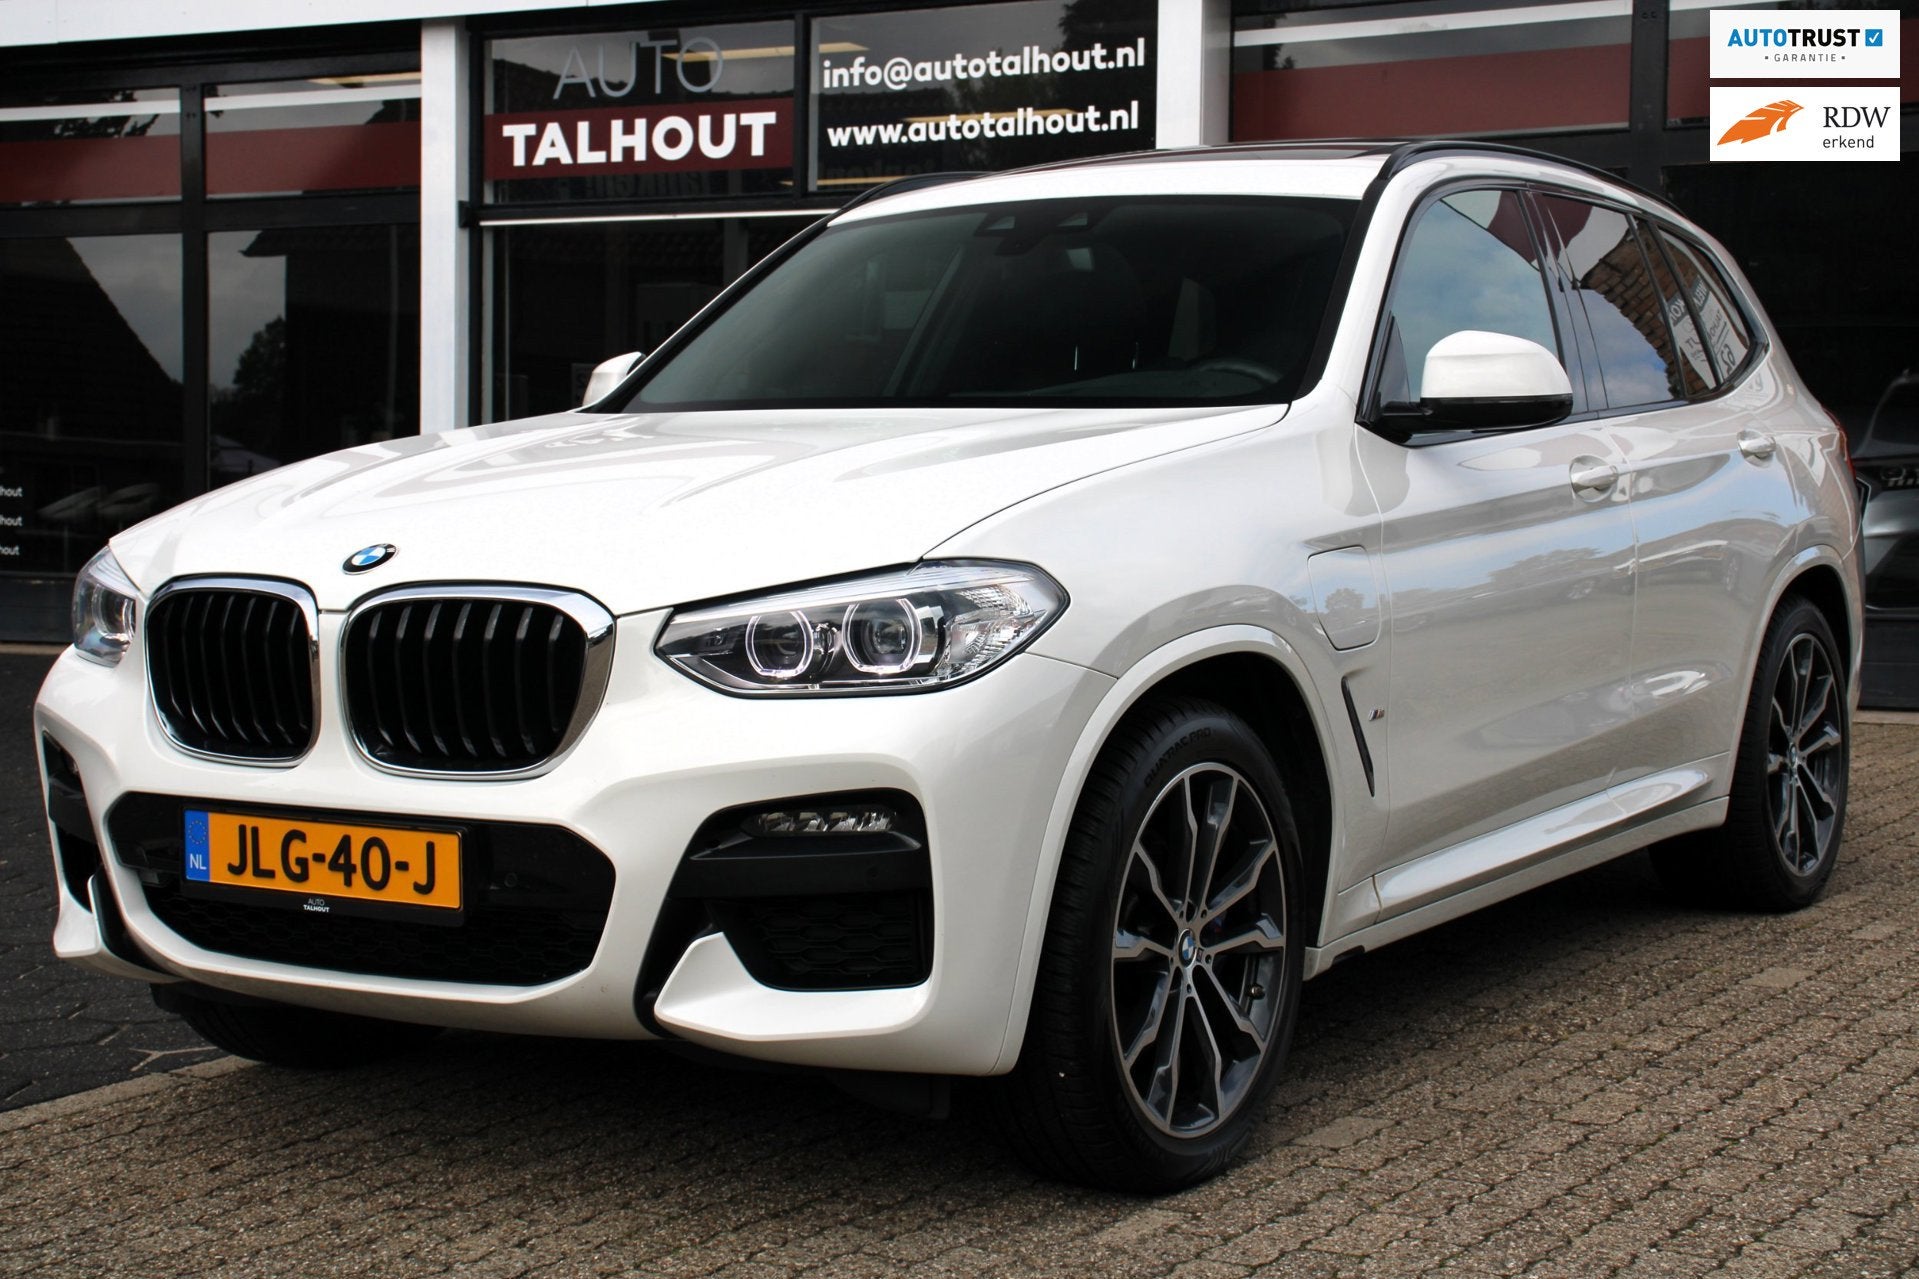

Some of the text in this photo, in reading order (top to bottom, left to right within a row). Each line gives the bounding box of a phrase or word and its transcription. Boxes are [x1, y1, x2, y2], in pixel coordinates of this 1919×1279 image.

[553, 36, 724, 100] AUTO
[822, 37, 1146, 90] info@autotalhout.nl
[502, 111, 777, 167] TALHOUT
[826, 100, 1139, 147] www.autotalhout.nl
[1188, 726, 1213, 745] PRO
[189, 853, 207, 871] NL
[227, 823, 436, 896] JLG-40-J
[303, 904, 330, 913] TALHOUT
